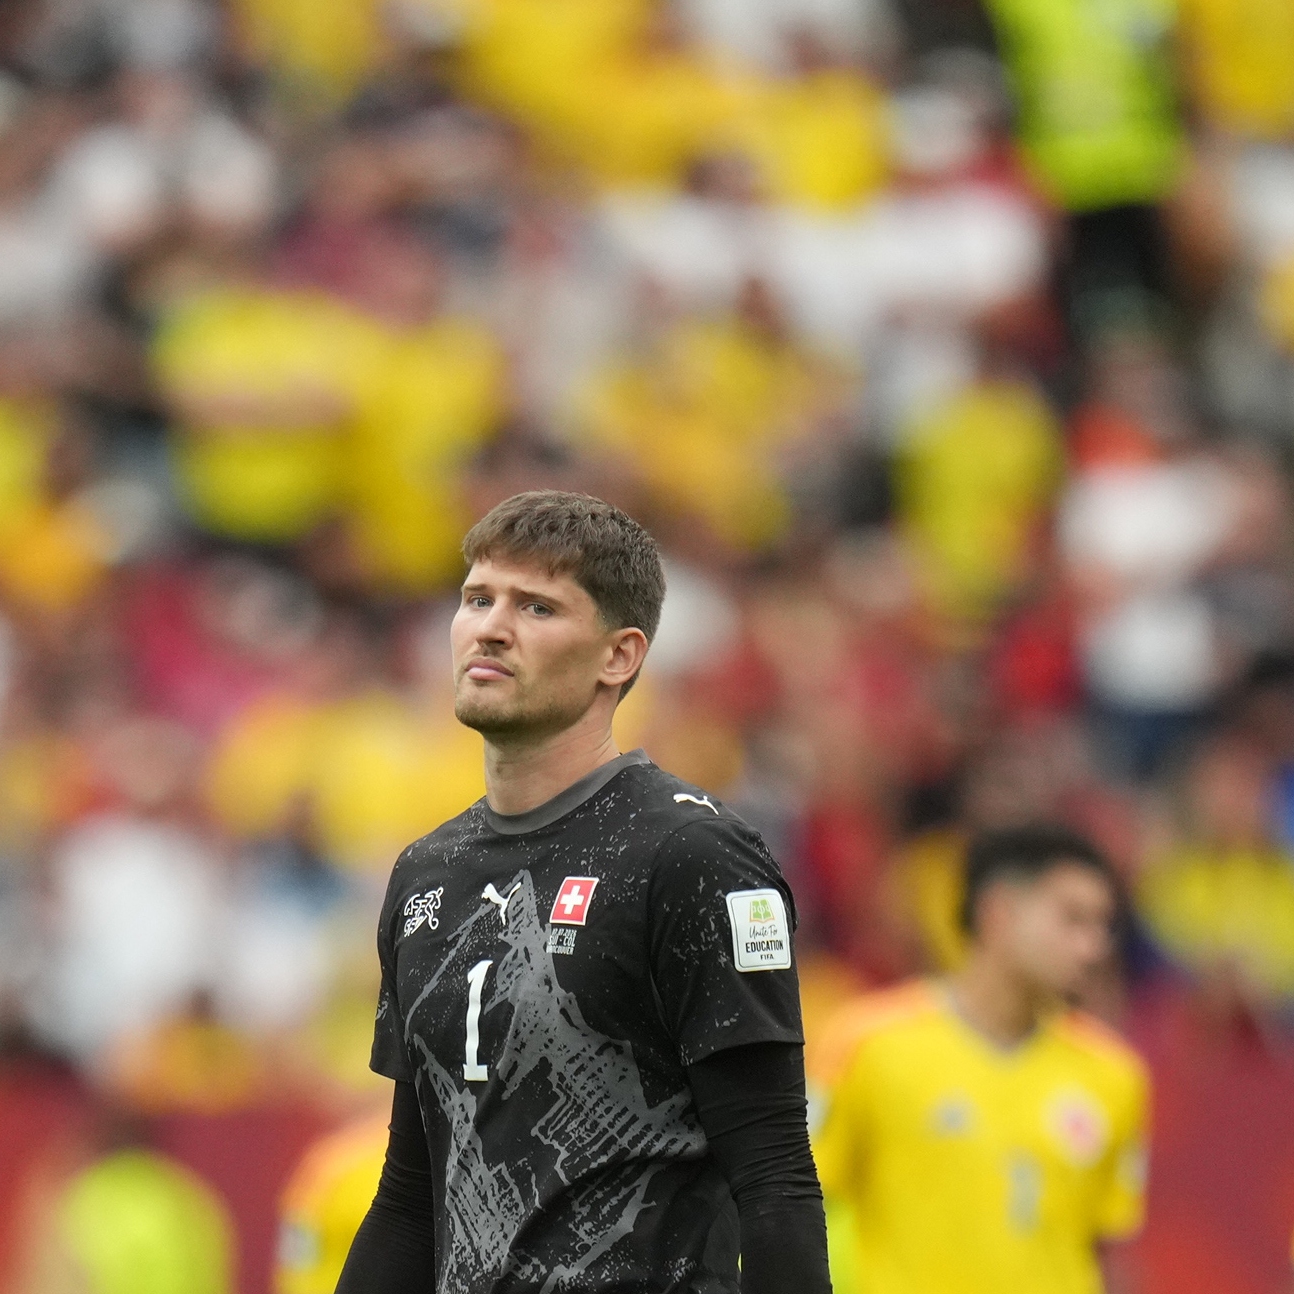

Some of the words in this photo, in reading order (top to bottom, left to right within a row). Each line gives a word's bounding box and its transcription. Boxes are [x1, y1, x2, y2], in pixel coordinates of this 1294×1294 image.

[749, 925, 768, 939] Unite
[768, 924, 778, 937] For
[745, 940, 784, 953] EDUCATION
[463, 960, 494, 1081] 1
